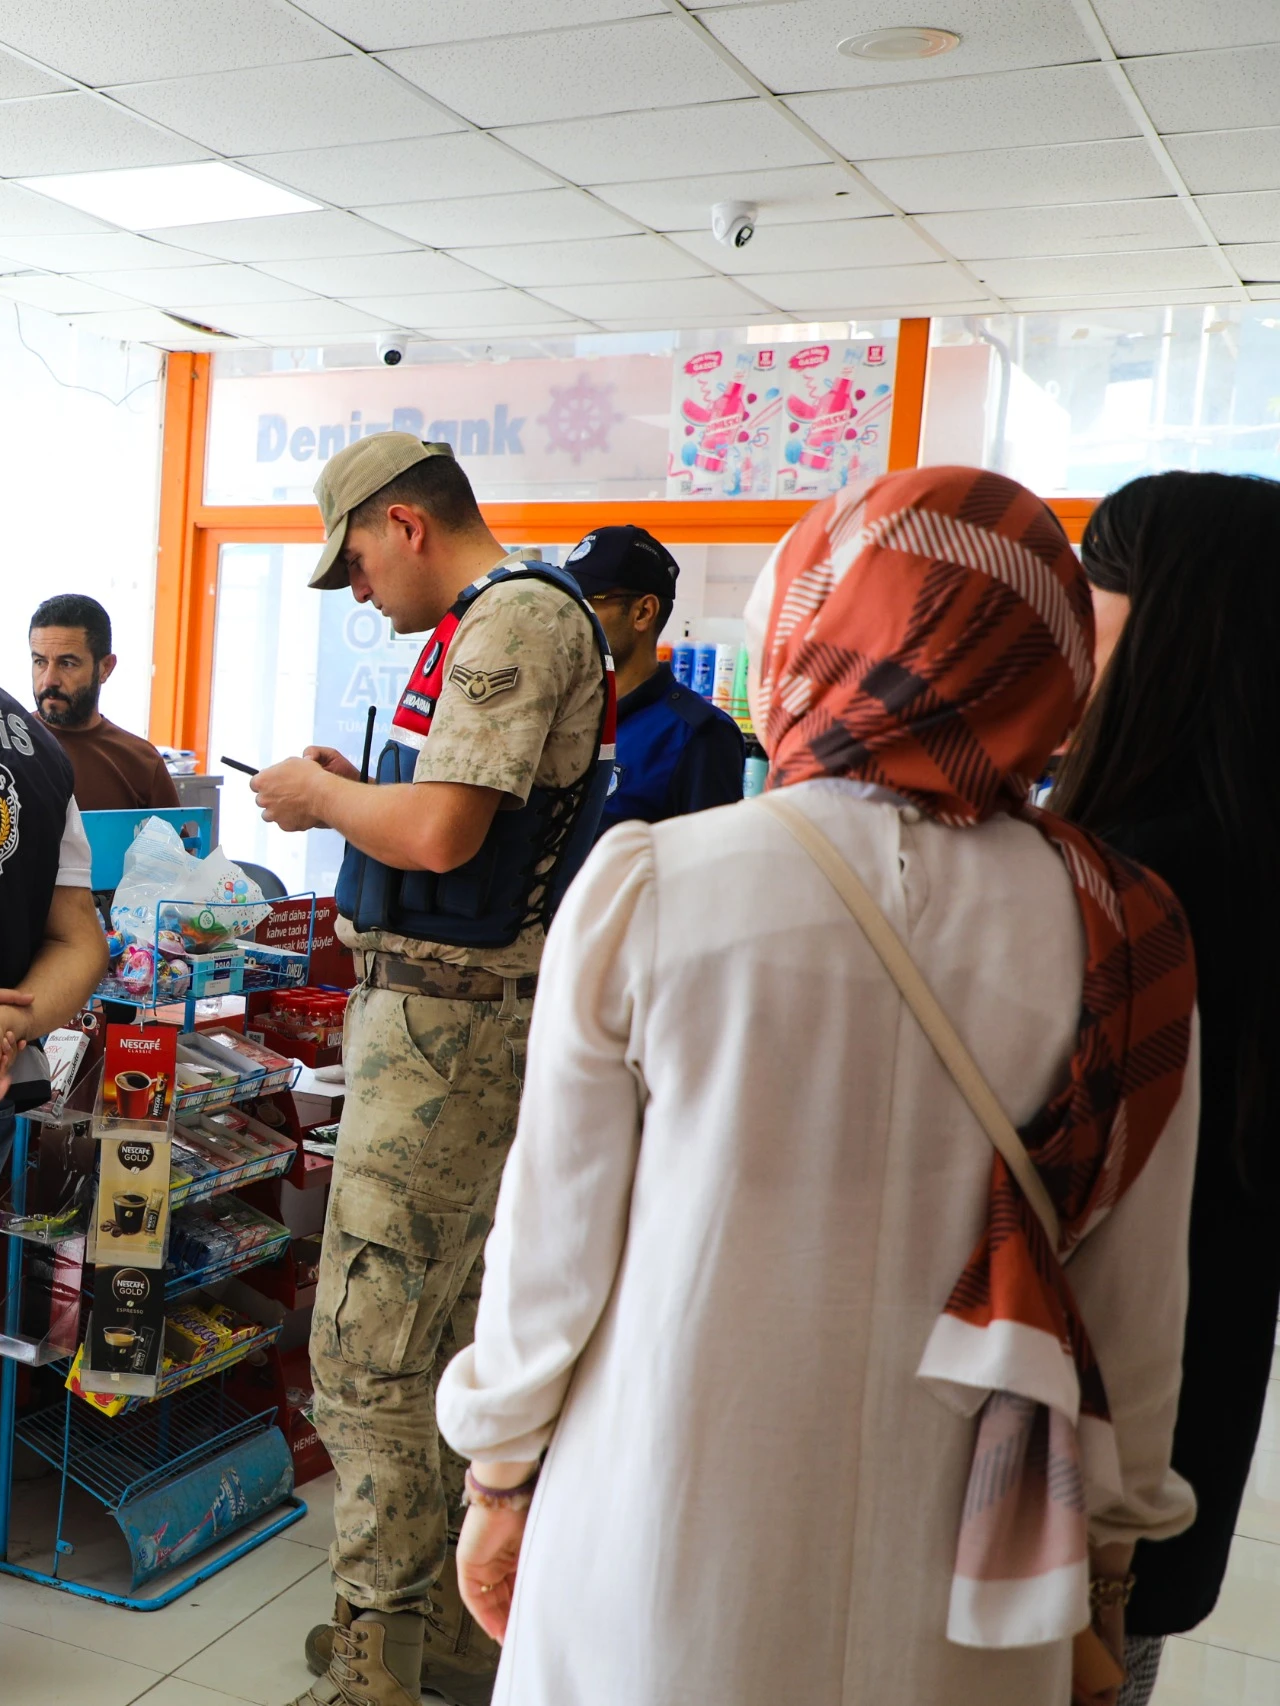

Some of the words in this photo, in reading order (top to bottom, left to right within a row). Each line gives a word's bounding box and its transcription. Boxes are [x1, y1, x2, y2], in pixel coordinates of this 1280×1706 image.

[268, 911, 288, 926] Şimdi
[288, 910, 305, 921] daha
[307, 907, 330, 922] zngin
[266, 927, 287, 939] kahve
[288, 926, 302, 936] tadı
[302, 924, 308, 935] &
[120, 1038, 161, 1050] NESCAFÉ
[124, 1154, 149, 1162] GOLD
[119, 1287, 143, 1296] GOLD
[116, 1307, 144, 1315] ESPRESSO
